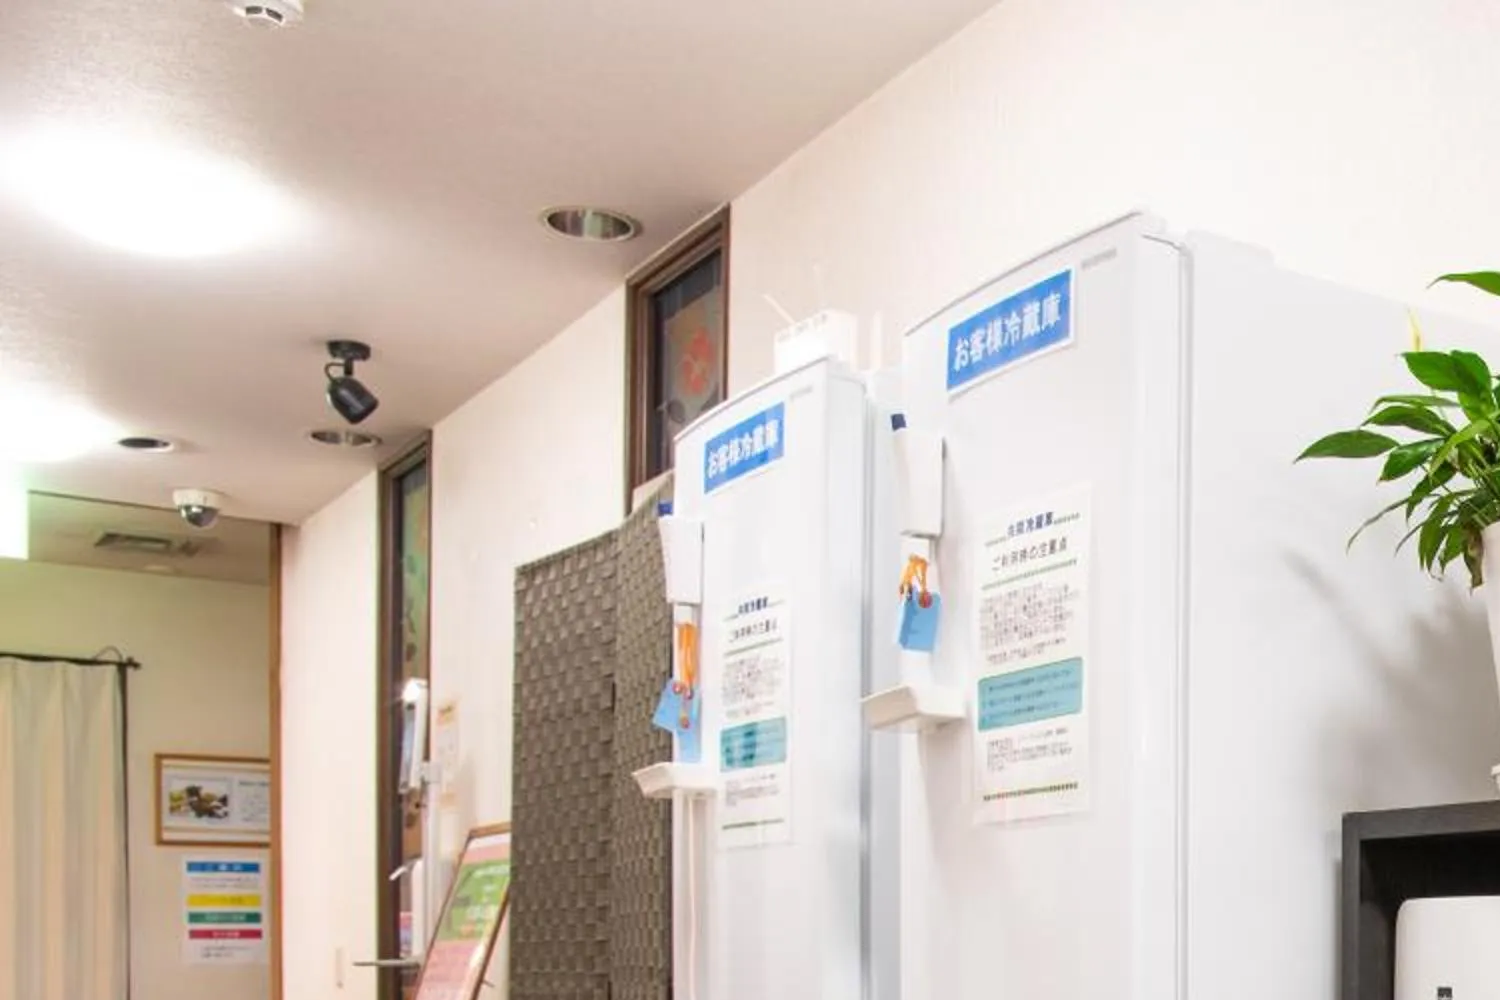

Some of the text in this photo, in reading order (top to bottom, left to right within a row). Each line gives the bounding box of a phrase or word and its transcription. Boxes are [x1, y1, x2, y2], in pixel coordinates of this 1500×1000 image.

[953, 293, 1061, 372] お客様冷蔵庫
